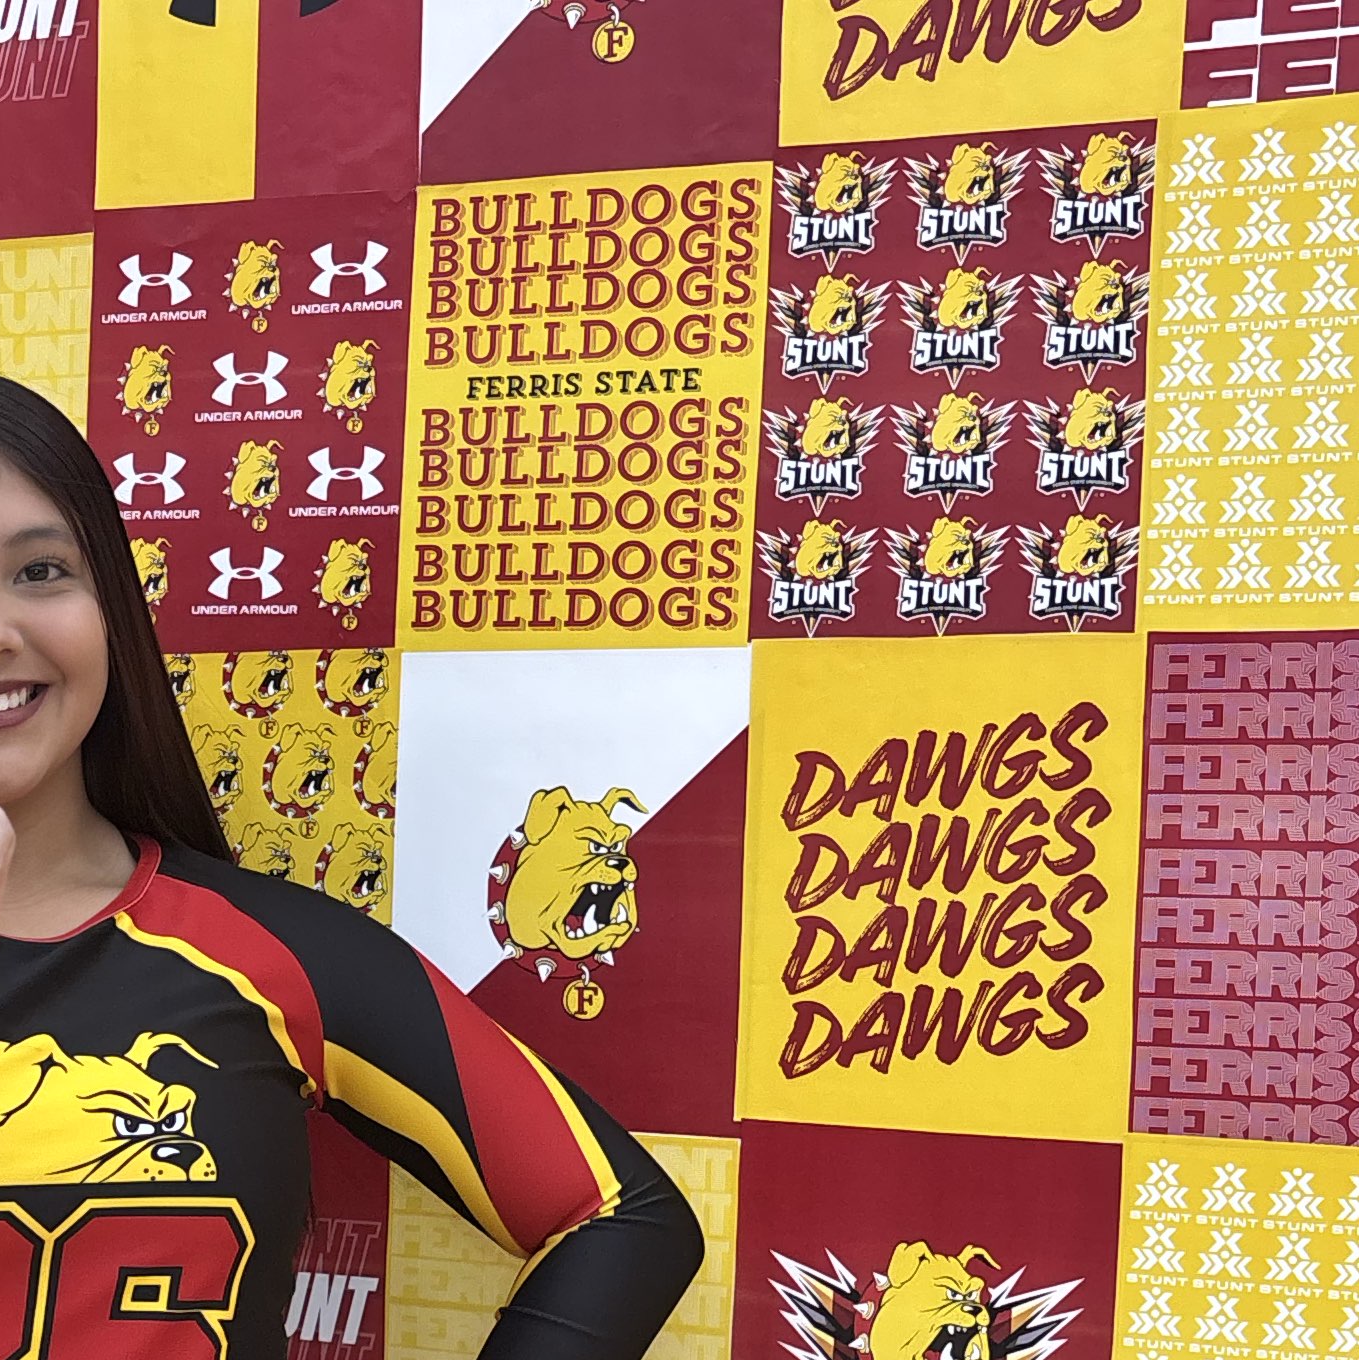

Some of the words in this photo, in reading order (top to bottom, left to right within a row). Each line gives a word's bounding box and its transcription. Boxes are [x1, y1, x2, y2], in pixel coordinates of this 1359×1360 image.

[603, 27, 628, 58] F
[431, 178, 761, 239] BULLDOGS
[920, 207, 1005, 242] STUNT
[1056, 198, 1141, 232] STUNT
[792, 212, 873, 249] STUNT
[429, 221, 757, 281] BULLDOGS
[291, 303, 340, 315] UNDER
[342, 300, 403, 312] ARMOUR
[427, 265, 755, 321] BULLDOGS
[101, 312, 147, 324] UNDER
[149, 310, 207, 322] ARMOUR
[425, 313, 754, 368] BULLDOGS
[786, 335, 866, 372] STUNT
[915, 330, 998, 364] STUNT
[1049, 324, 1134, 355] STUNT
[466, 372, 580, 399] FERRIS
[595, 368, 702, 395] STATE
[194, 411, 242, 423] UNDER
[243, 410, 303, 421] ARMOUR
[421, 398, 750, 448] BULLDOGS
[420, 440, 746, 489] BULLDOGS
[780, 458, 860, 493] STUNT
[908, 453, 991, 488] STUNT
[1042, 447, 1126, 483] STUNT
[143, 510, 200, 520] ARMOUR
[289, 507, 337, 517] UNDER
[339, 505, 399, 516] ARMOUR
[417, 489, 745, 536] BULLDOGS
[415, 540, 742, 585] BULLDOGS
[412, 587, 740, 631] BULLDOGS
[774, 582, 853, 616] STUNT
[903, 577, 983, 610] STUNT
[1036, 575, 1119, 608] STUNT
[1144, 594, 1206, 605] STUNT
[1210, 593, 1274, 604] STUNT
[1279, 592, 1346, 603] STUNT
[191, 605, 238, 615] UNDER
[239, 605, 298, 615] ARMOUR
[780, 701, 1108, 831] DAWGS
[785, 788, 1112, 912] DAWGS
[781, 874, 1106, 994] DAWGS
[574, 986, 598, 1015] F
[778, 963, 1105, 1079] DAWGS
[1129, 1211, 1190, 1222] STUNT
[1196, 1215, 1258, 1228] STUNT
[1263, 1220, 1326, 1231] STUNT
